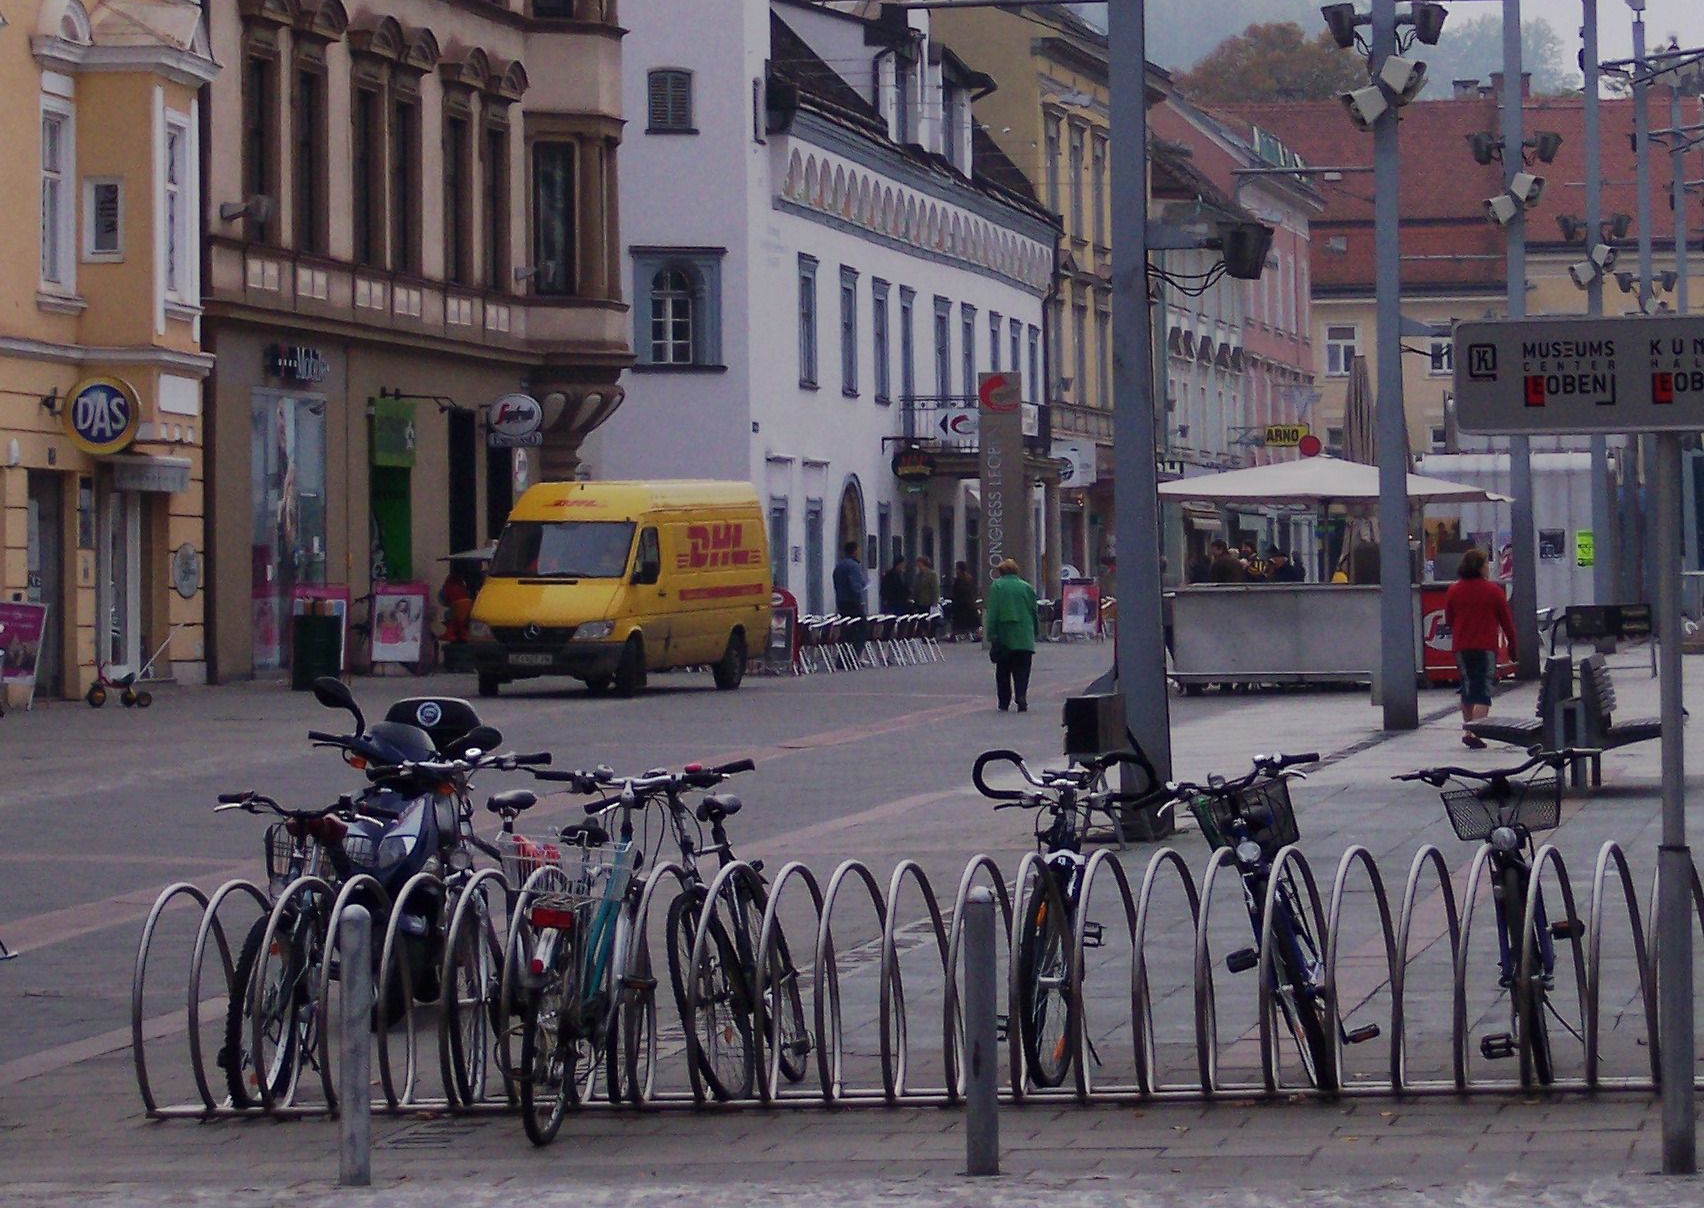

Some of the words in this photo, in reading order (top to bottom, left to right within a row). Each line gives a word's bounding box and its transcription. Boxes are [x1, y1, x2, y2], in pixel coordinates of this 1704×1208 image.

[1522, 340, 1615, 359] MUSEUMS
[1650, 338, 1704, 356] KUN
[1523, 360, 1616, 372] CENTER
[1524, 374, 1609, 407] LEOBEN
[76, 391, 128, 438] DAS
[1266, 428, 1299, 443] ARNO
[687, 523, 750, 569] DHL
[987, 491, 1003, 582] CONGRESS
